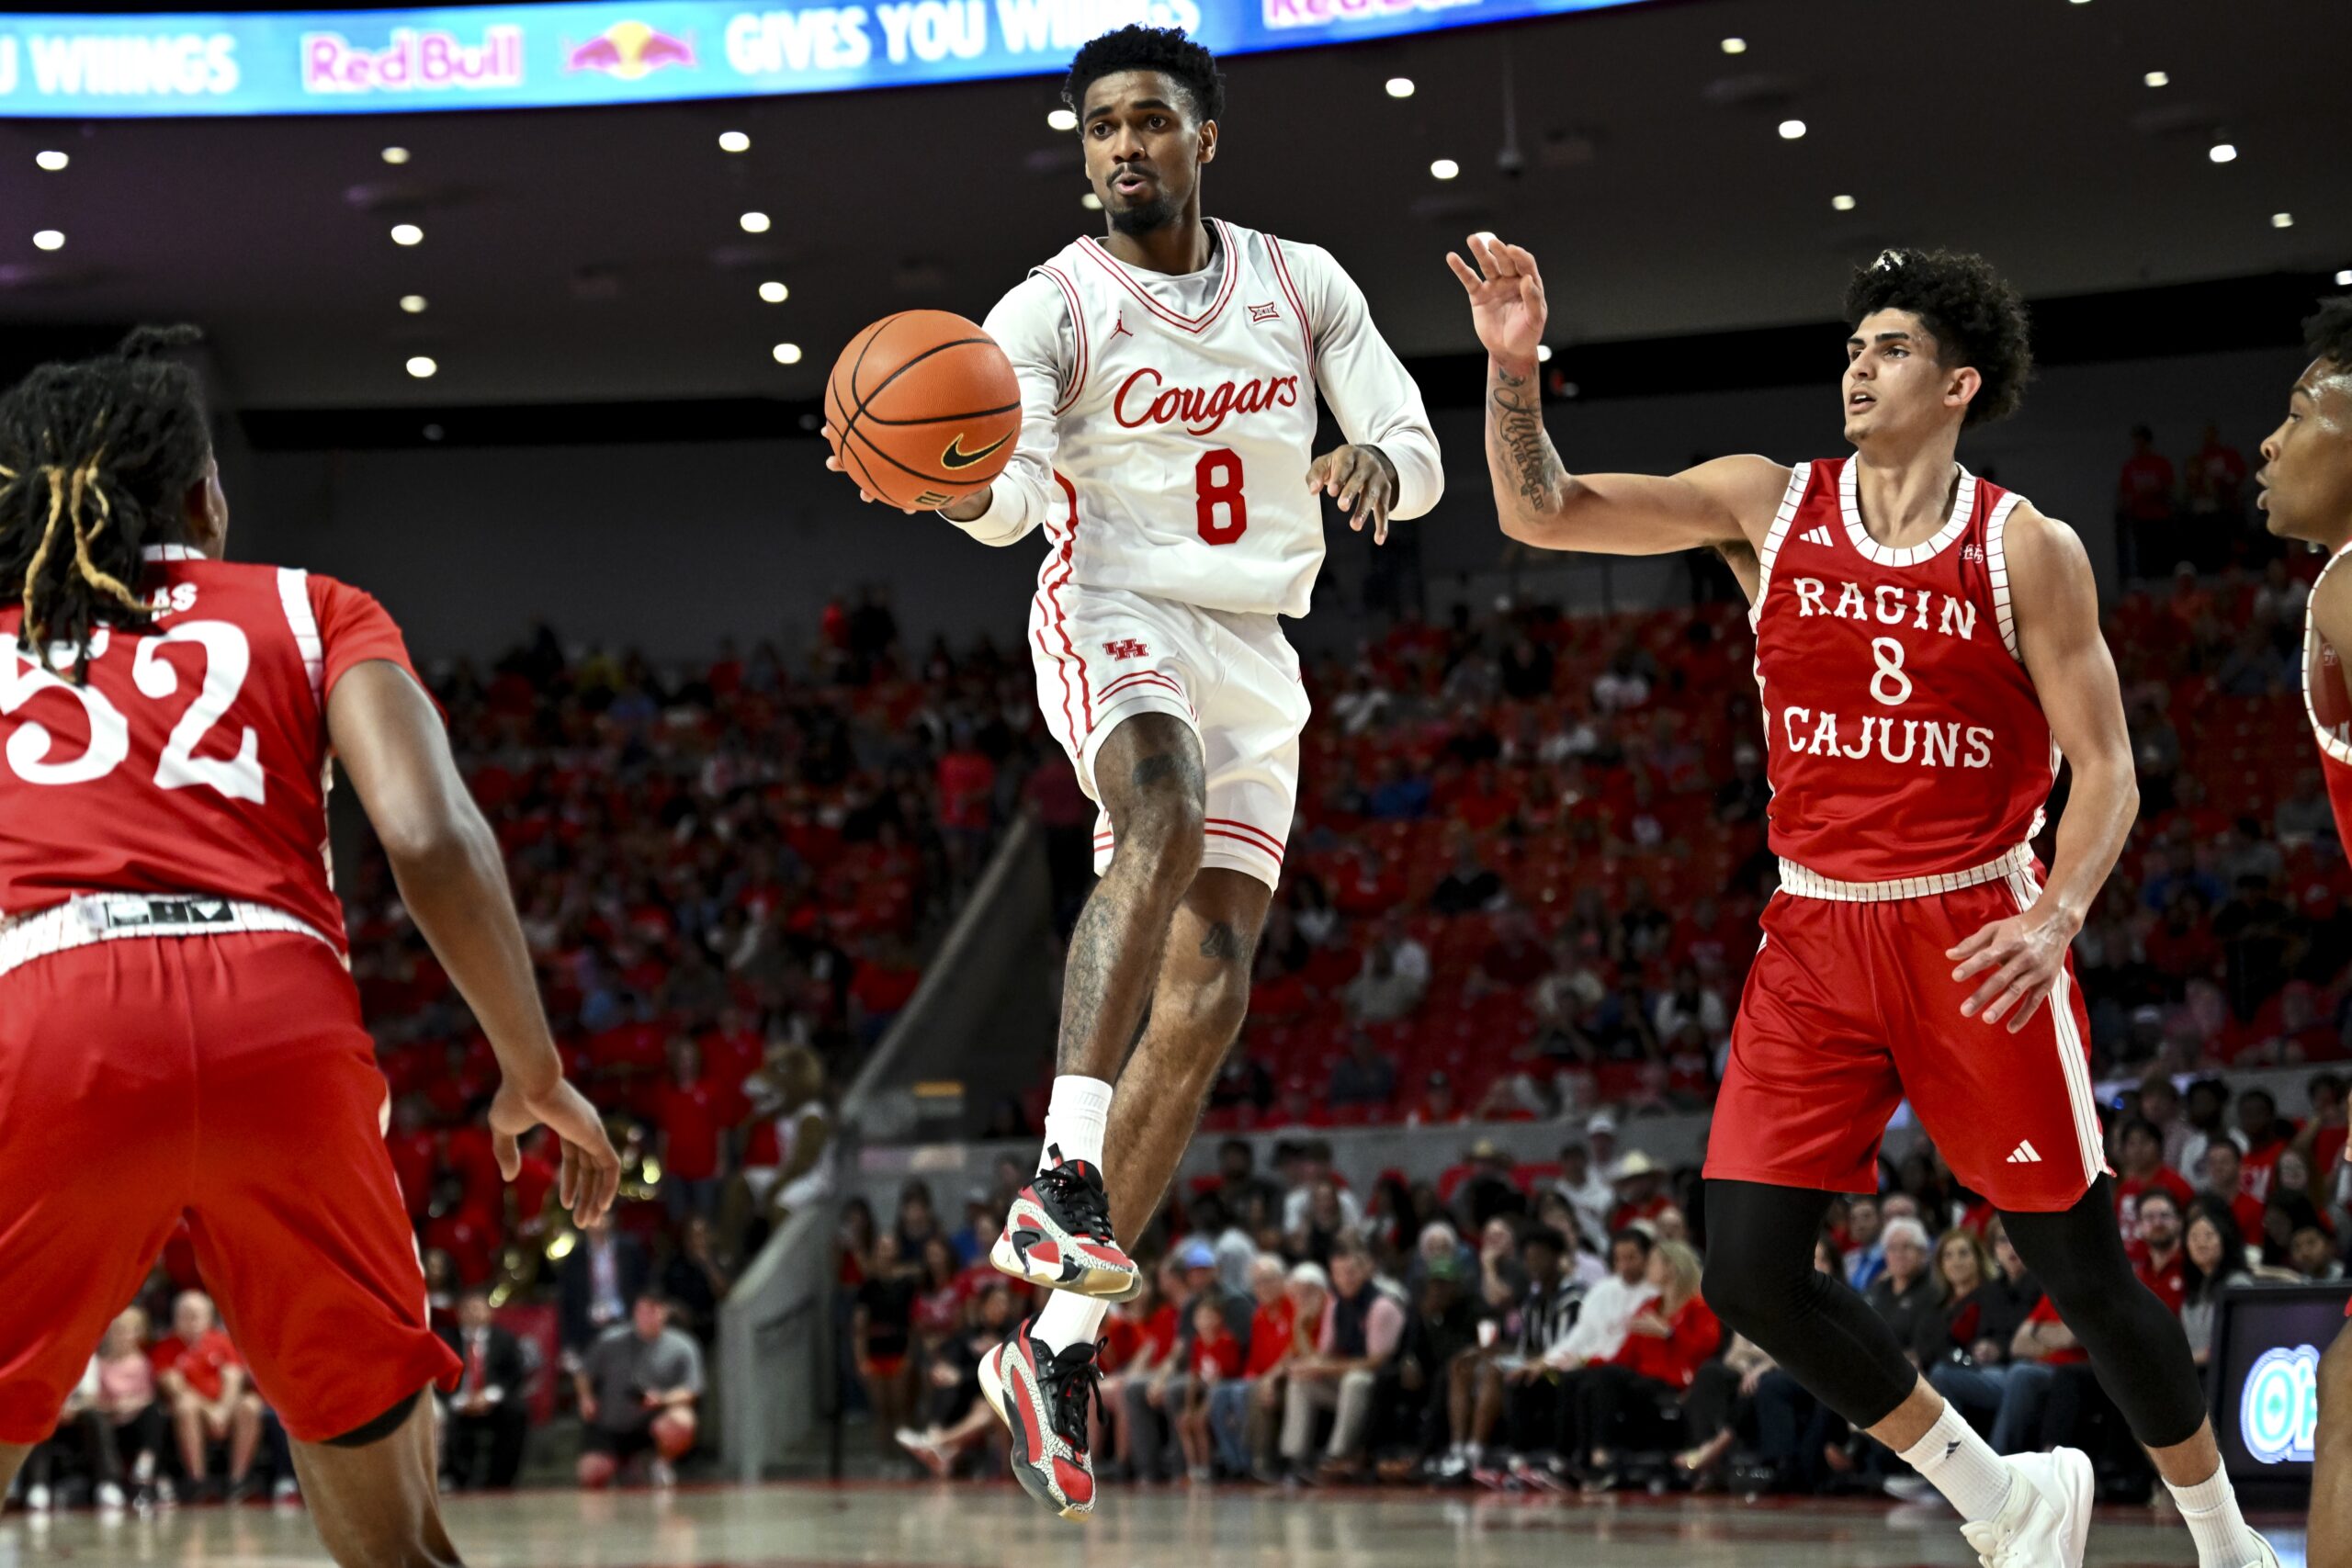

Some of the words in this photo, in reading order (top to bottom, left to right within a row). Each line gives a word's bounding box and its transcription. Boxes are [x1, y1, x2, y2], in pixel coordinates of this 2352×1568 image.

[305, 30, 411, 90] Red
[416, 28, 519, 85] Bull
[725, 6, 872, 74] GIVES
[876, 0, 984, 64] YOU
[1114, 367, 1297, 436] Cougars
[1195, 447, 1248, 546] 8
[1793, 577, 1976, 640] RAGIN
[1870, 637, 1913, 706] 8
[0, 620, 266, 805] 52
[1783, 706, 1995, 769] CAJUNS
